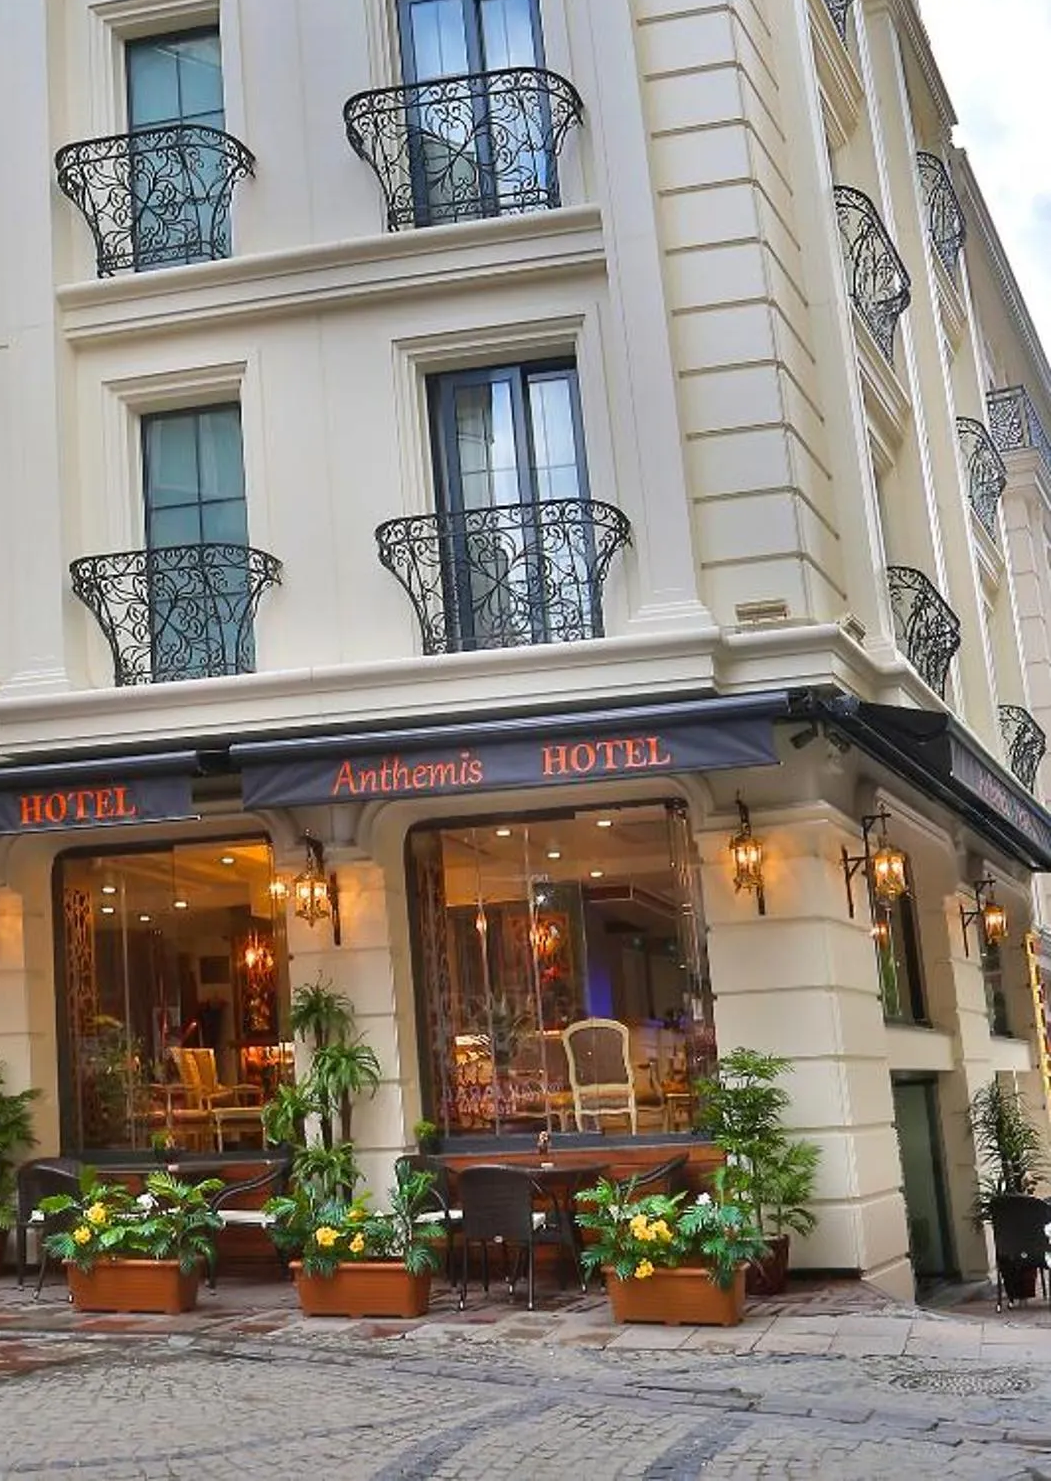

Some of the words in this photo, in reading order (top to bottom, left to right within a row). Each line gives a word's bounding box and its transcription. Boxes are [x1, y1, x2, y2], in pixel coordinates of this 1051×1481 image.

[332, 749, 484, 796] Anthemis
[542, 737, 671, 776] HOTEL
[20, 787, 136, 825] HOTEL
